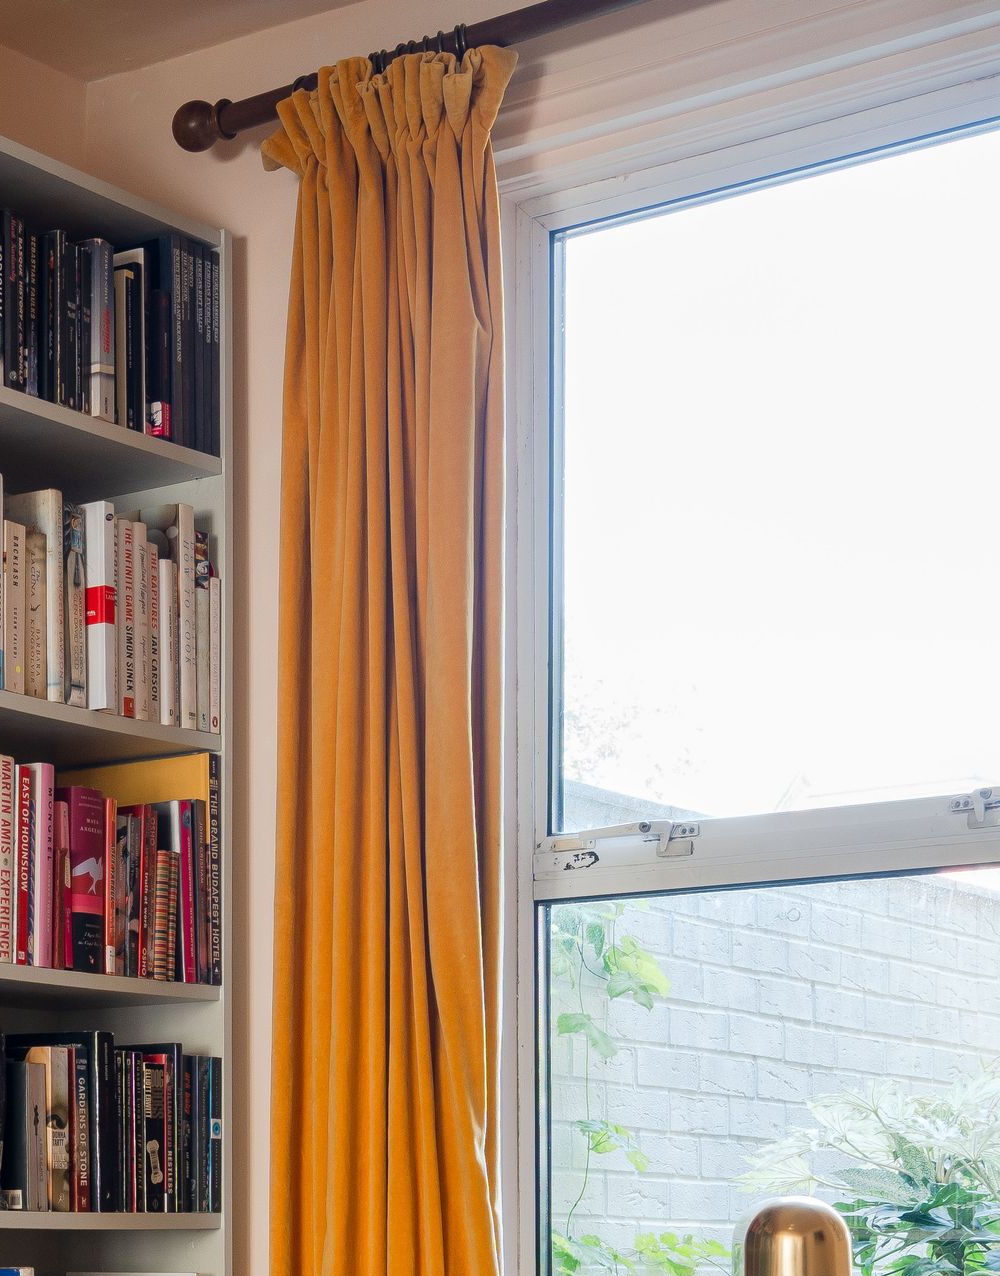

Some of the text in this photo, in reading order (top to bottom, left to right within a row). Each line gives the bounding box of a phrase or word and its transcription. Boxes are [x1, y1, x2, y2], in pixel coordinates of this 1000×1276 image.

[1, 760, 11, 854] MARTIN AMIS
[22, 808, 29, 823] OF
[0, 869, 10, 958] EXPERIENCE
[79, 1077, 87, 1128] GARDENS
[80, 1133, 87, 1148] OF
